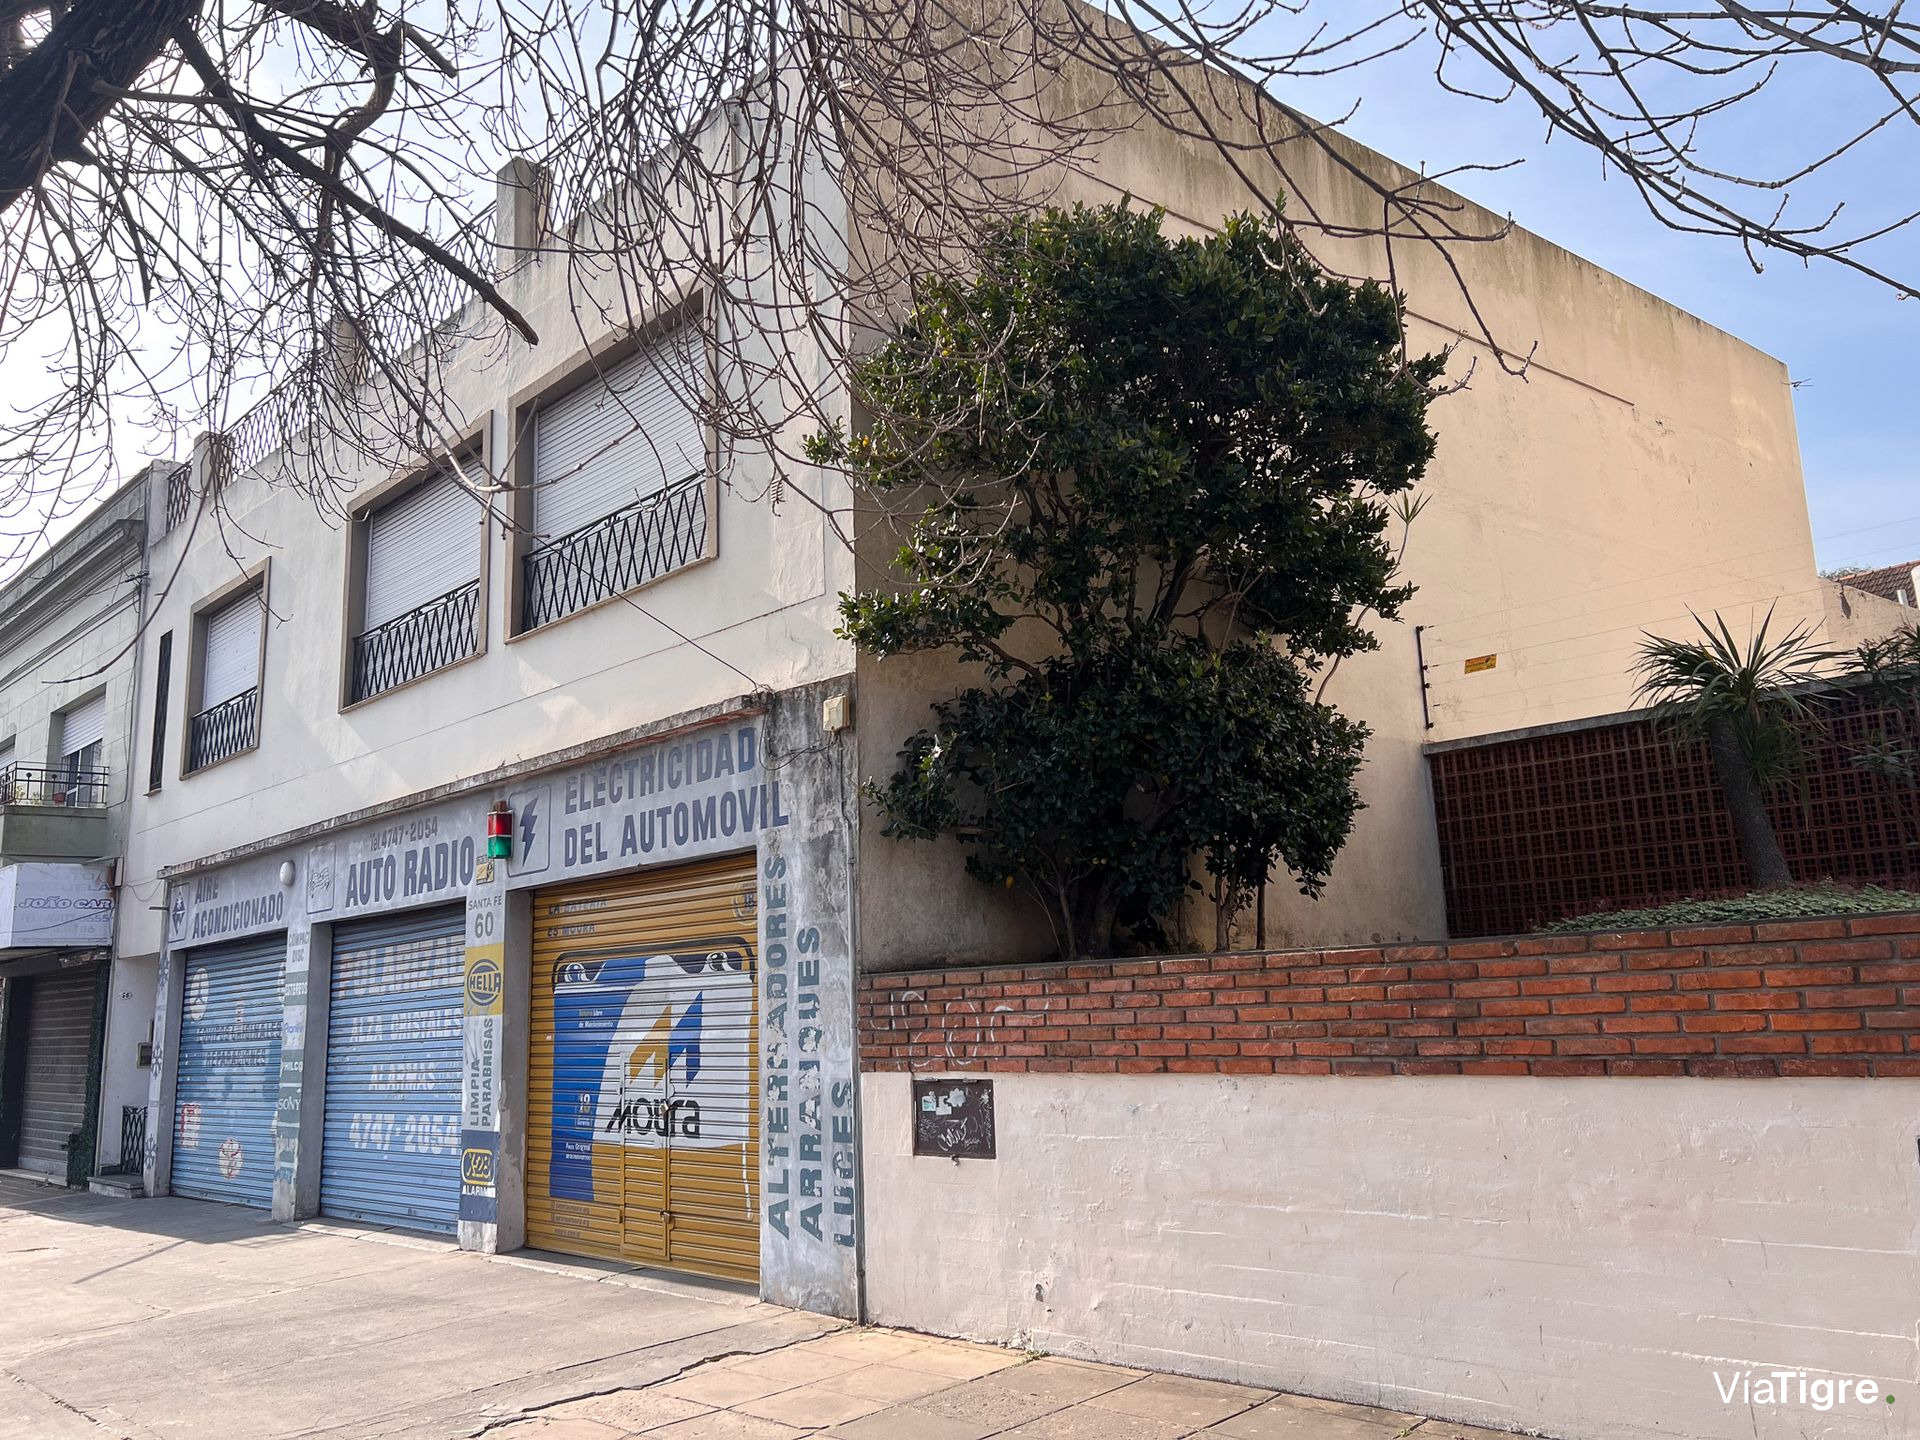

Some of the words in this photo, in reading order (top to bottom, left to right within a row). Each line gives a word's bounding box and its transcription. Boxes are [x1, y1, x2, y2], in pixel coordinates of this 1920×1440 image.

[565, 727, 756, 815] ELECTRICIDAD
[564, 822, 608, 868] DEL
[620, 780, 789, 857] AUTOMOVIL
[195, 876, 219, 904] AIRE
[345, 855, 396, 908] AUTO
[404, 836, 475, 898] RADIO
[19, 896, 72, 910] JOÃO
[73, 898, 112, 910] CAR
[192, 891, 284, 939] ACONDICIONADO
[468, 897, 492, 911] SANTA
[493, 895, 503, 907] FE
[475, 911, 494, 938] 60
[292, 948, 305, 963] DISC
[469, 972, 501, 994] HELLA
[350, 1014, 383, 1042] ALZA
[481, 1017, 494, 1127] PARABRISAS
[278, 1096, 301, 1111] SONY
[470, 1059, 480, 1127] LIMPIA
[349, 1112, 459, 1156] 4747-2054
[831, 1081, 856, 1248] LUCES
